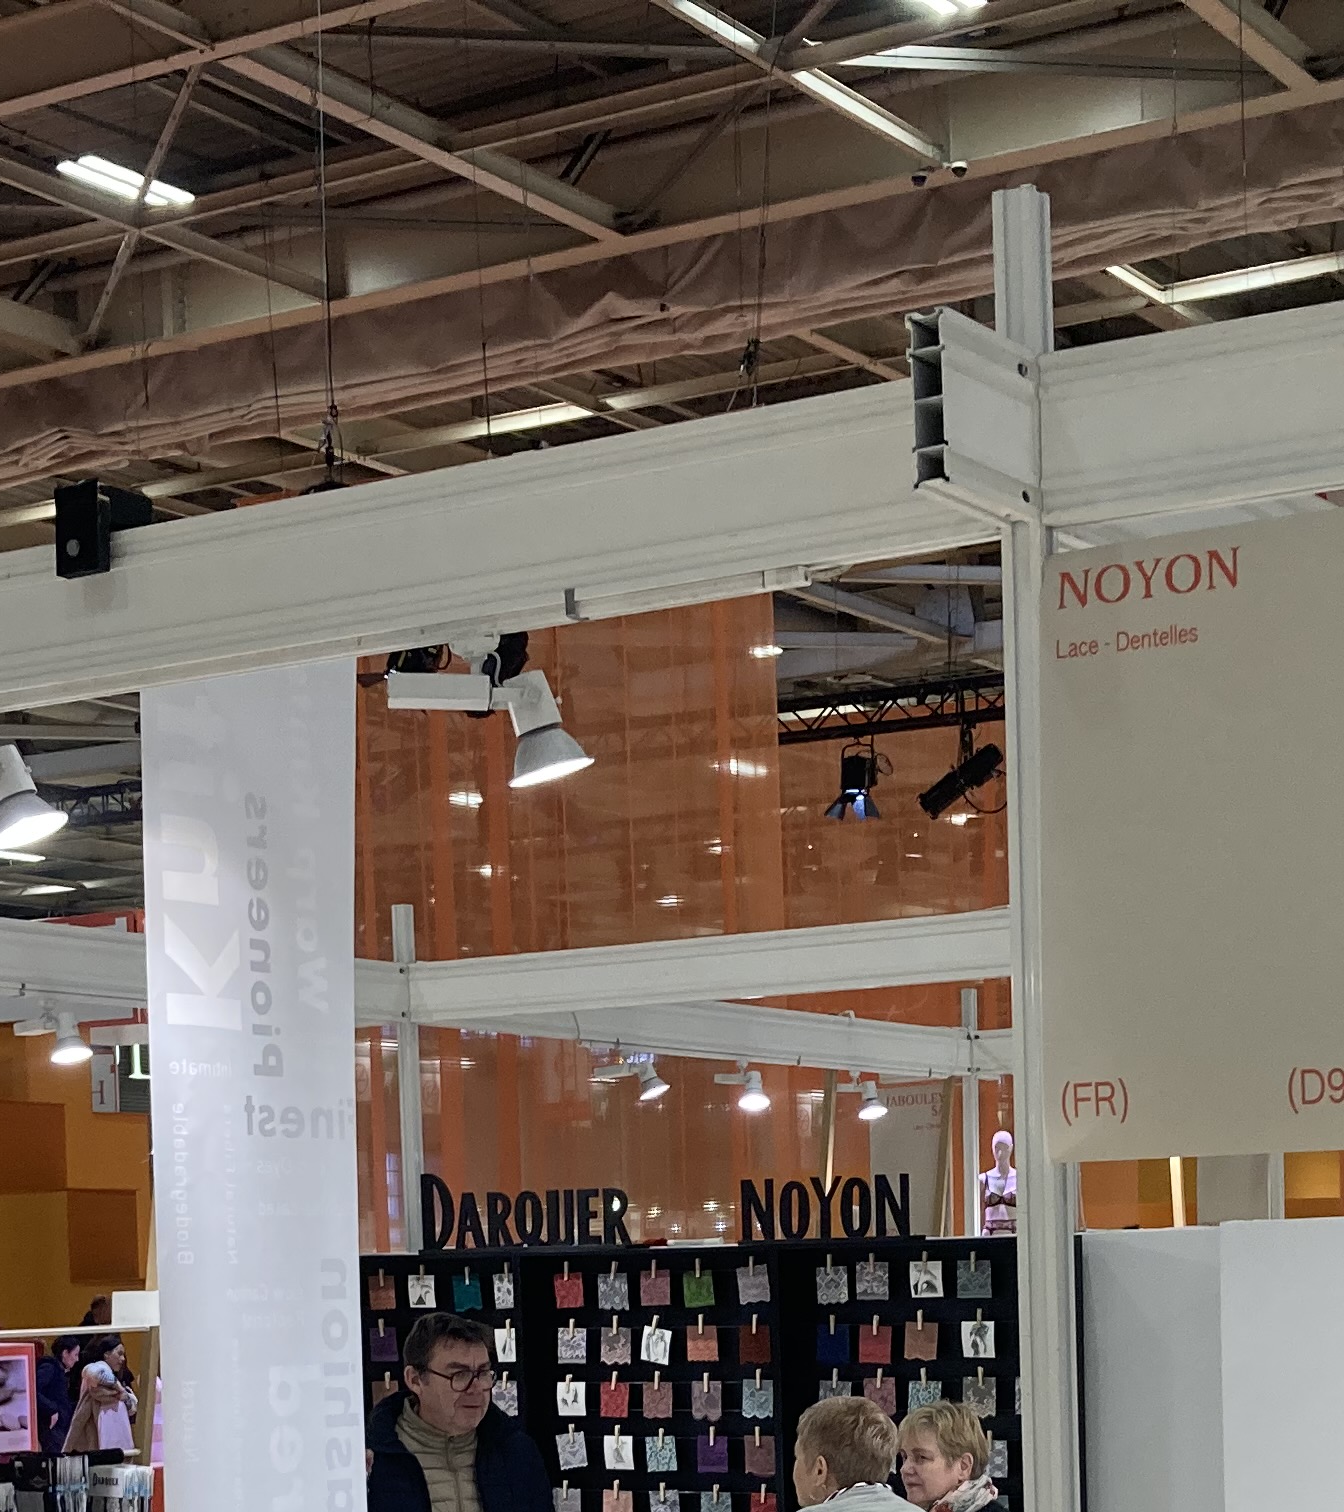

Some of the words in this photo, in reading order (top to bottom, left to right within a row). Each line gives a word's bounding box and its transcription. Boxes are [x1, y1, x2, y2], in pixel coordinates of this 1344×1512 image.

[1057, 546, 1240, 610] NOYON
[1056, 638, 1099, 660] Lace
[1116, 624, 1199, 652] Dentelles
[1061, 1077, 1129, 1126] (FR)
[420, 1173, 635, 1249] DARQUER
[740, 1173, 911, 1241] NOYON
